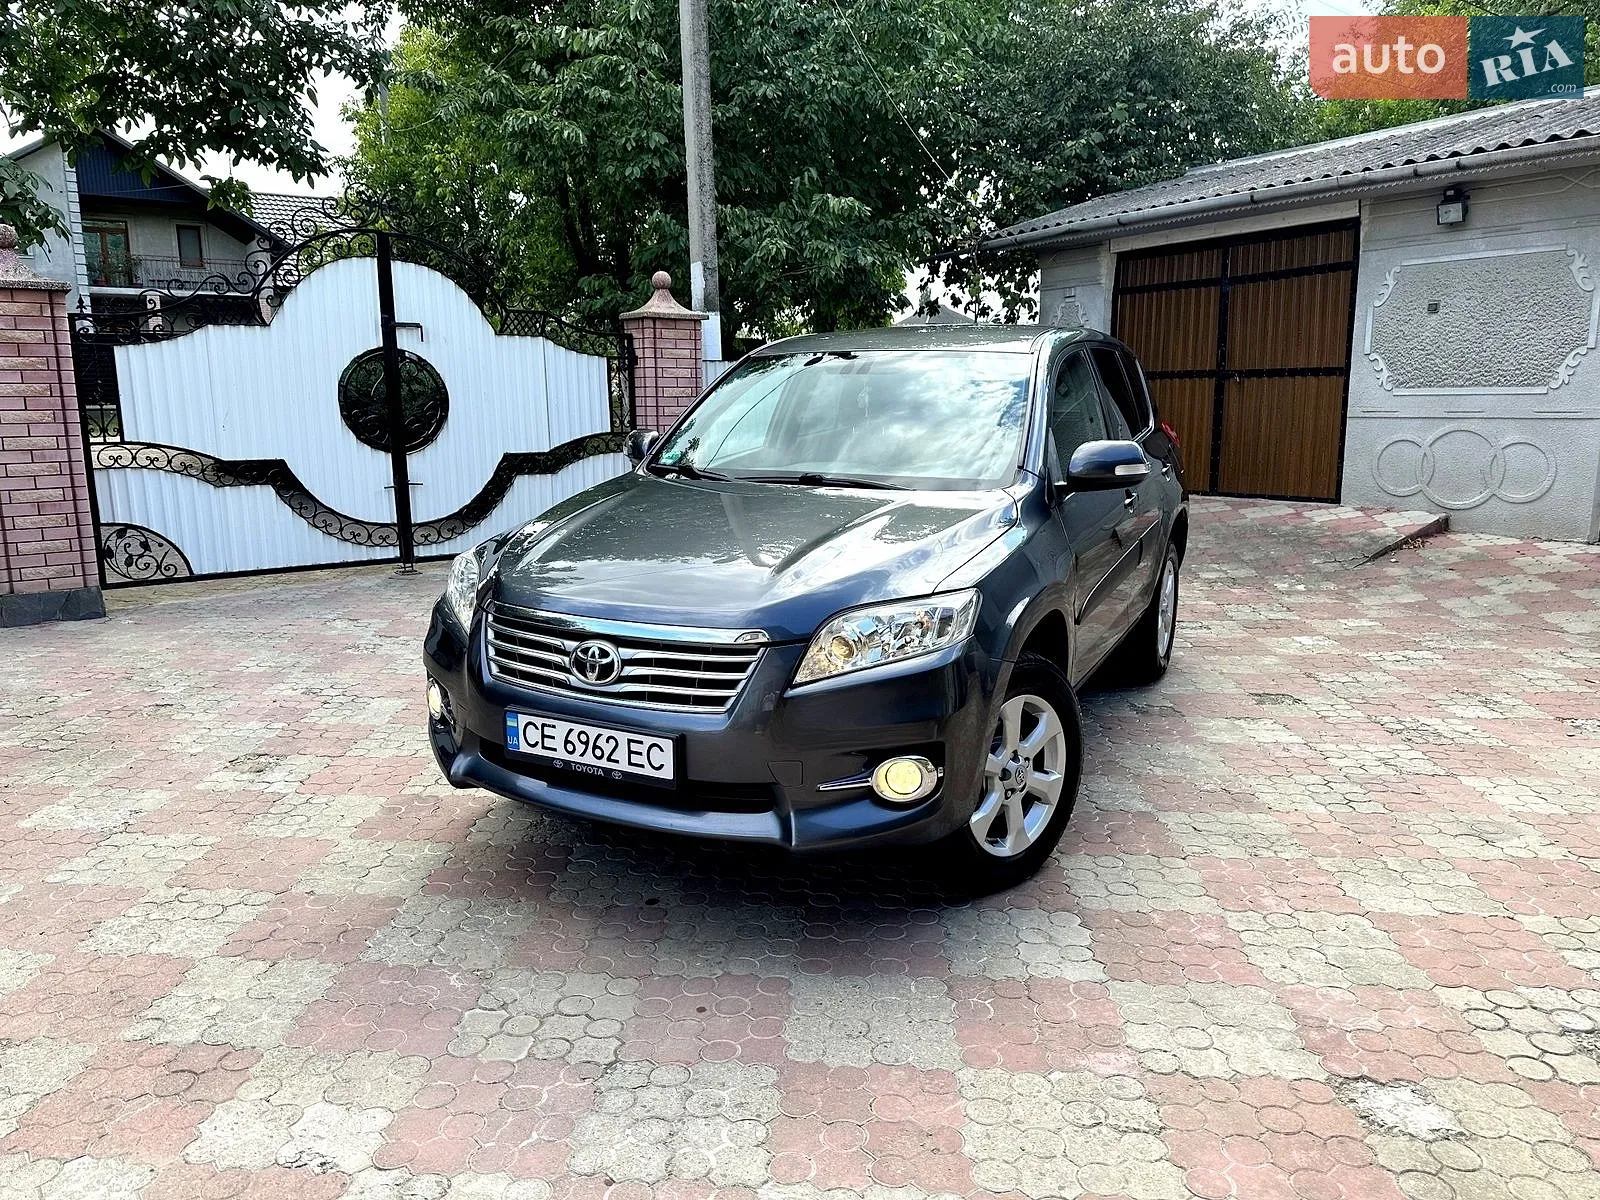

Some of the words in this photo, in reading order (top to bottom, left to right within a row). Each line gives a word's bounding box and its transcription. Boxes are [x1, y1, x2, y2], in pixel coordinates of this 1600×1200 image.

[507, 736, 519, 745] UA
[522, 721, 557, 752] CE
[563, 728, 620, 764] 6962
[627, 738, 665, 771] EC
[571, 762, 604, 776] TOYOTA
